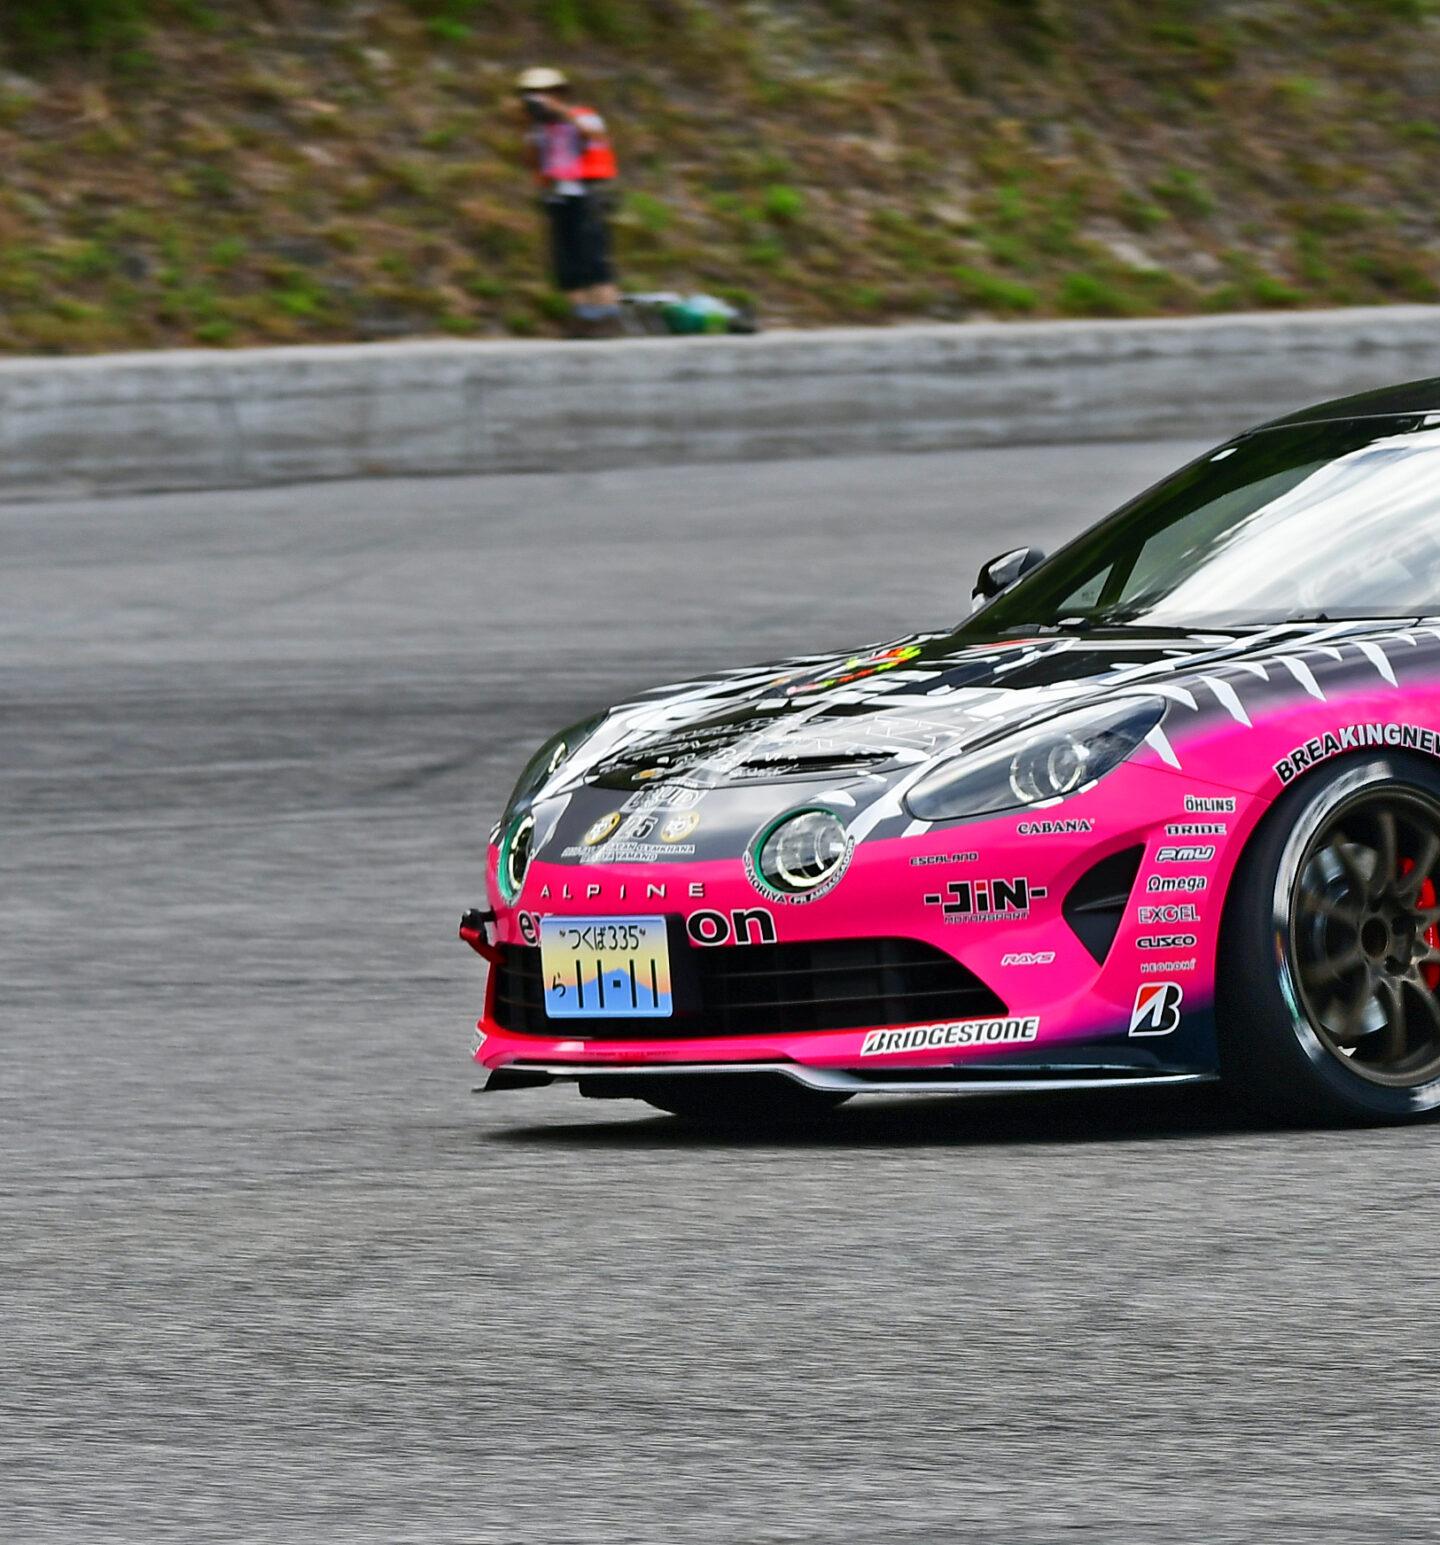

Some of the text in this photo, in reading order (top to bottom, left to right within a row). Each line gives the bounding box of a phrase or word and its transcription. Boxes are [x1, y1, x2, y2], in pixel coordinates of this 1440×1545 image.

[1186, 797, 1234, 812] ÖHLINS
[1018, 820, 1091, 834] CABANA
[1167, 825, 1225, 834] BRIDE
[540, 882, 706, 899] ALPINE
[864, 1019, 1036, 1055] BRIDGESTONE
